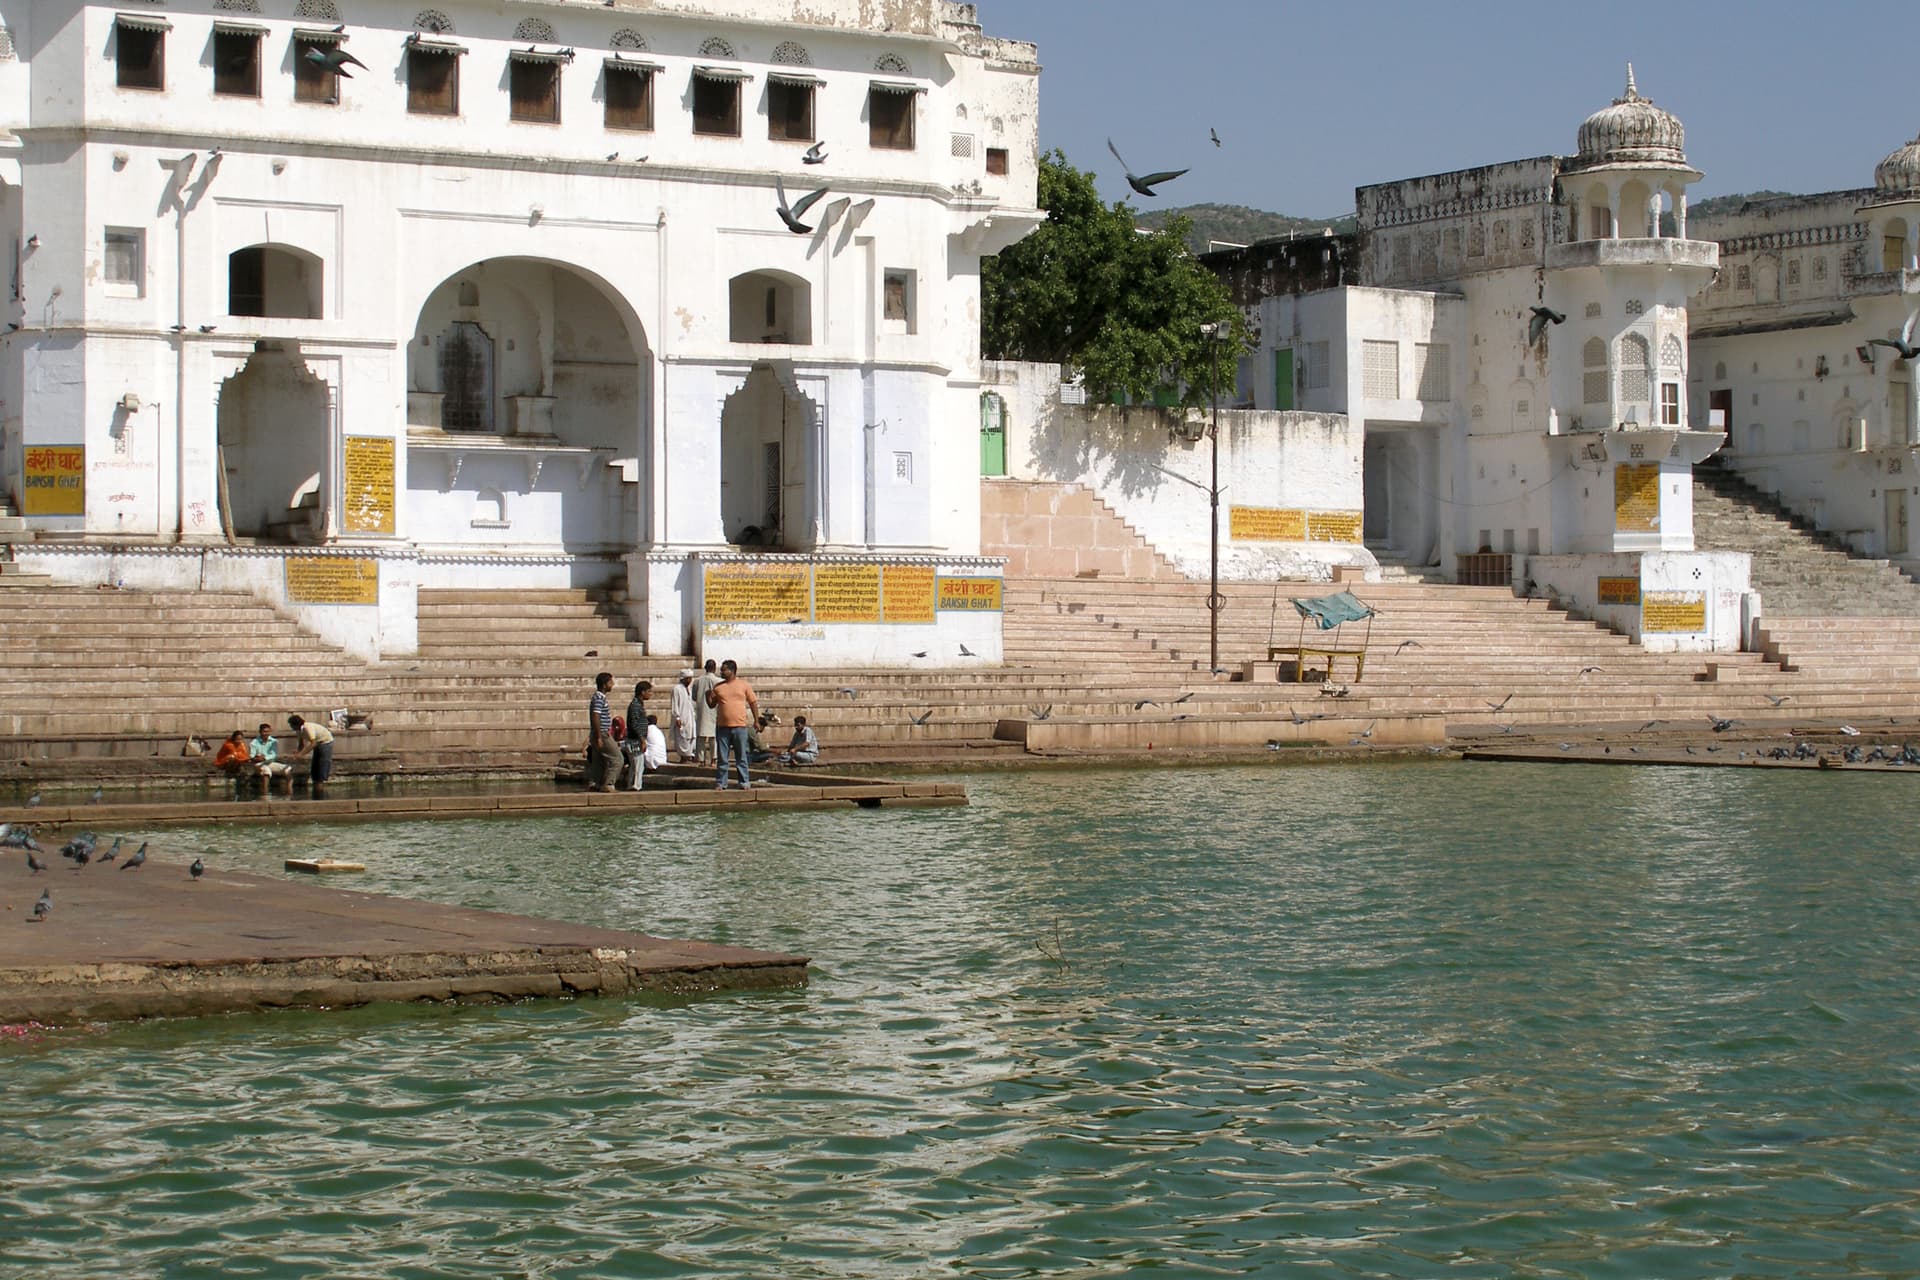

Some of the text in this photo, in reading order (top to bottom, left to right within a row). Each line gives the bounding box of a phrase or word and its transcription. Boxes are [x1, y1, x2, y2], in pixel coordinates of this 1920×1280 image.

[58, 452, 82, 470] घाट
[971, 583, 996, 595] घाट
[971, 598, 993, 608] GHAT
